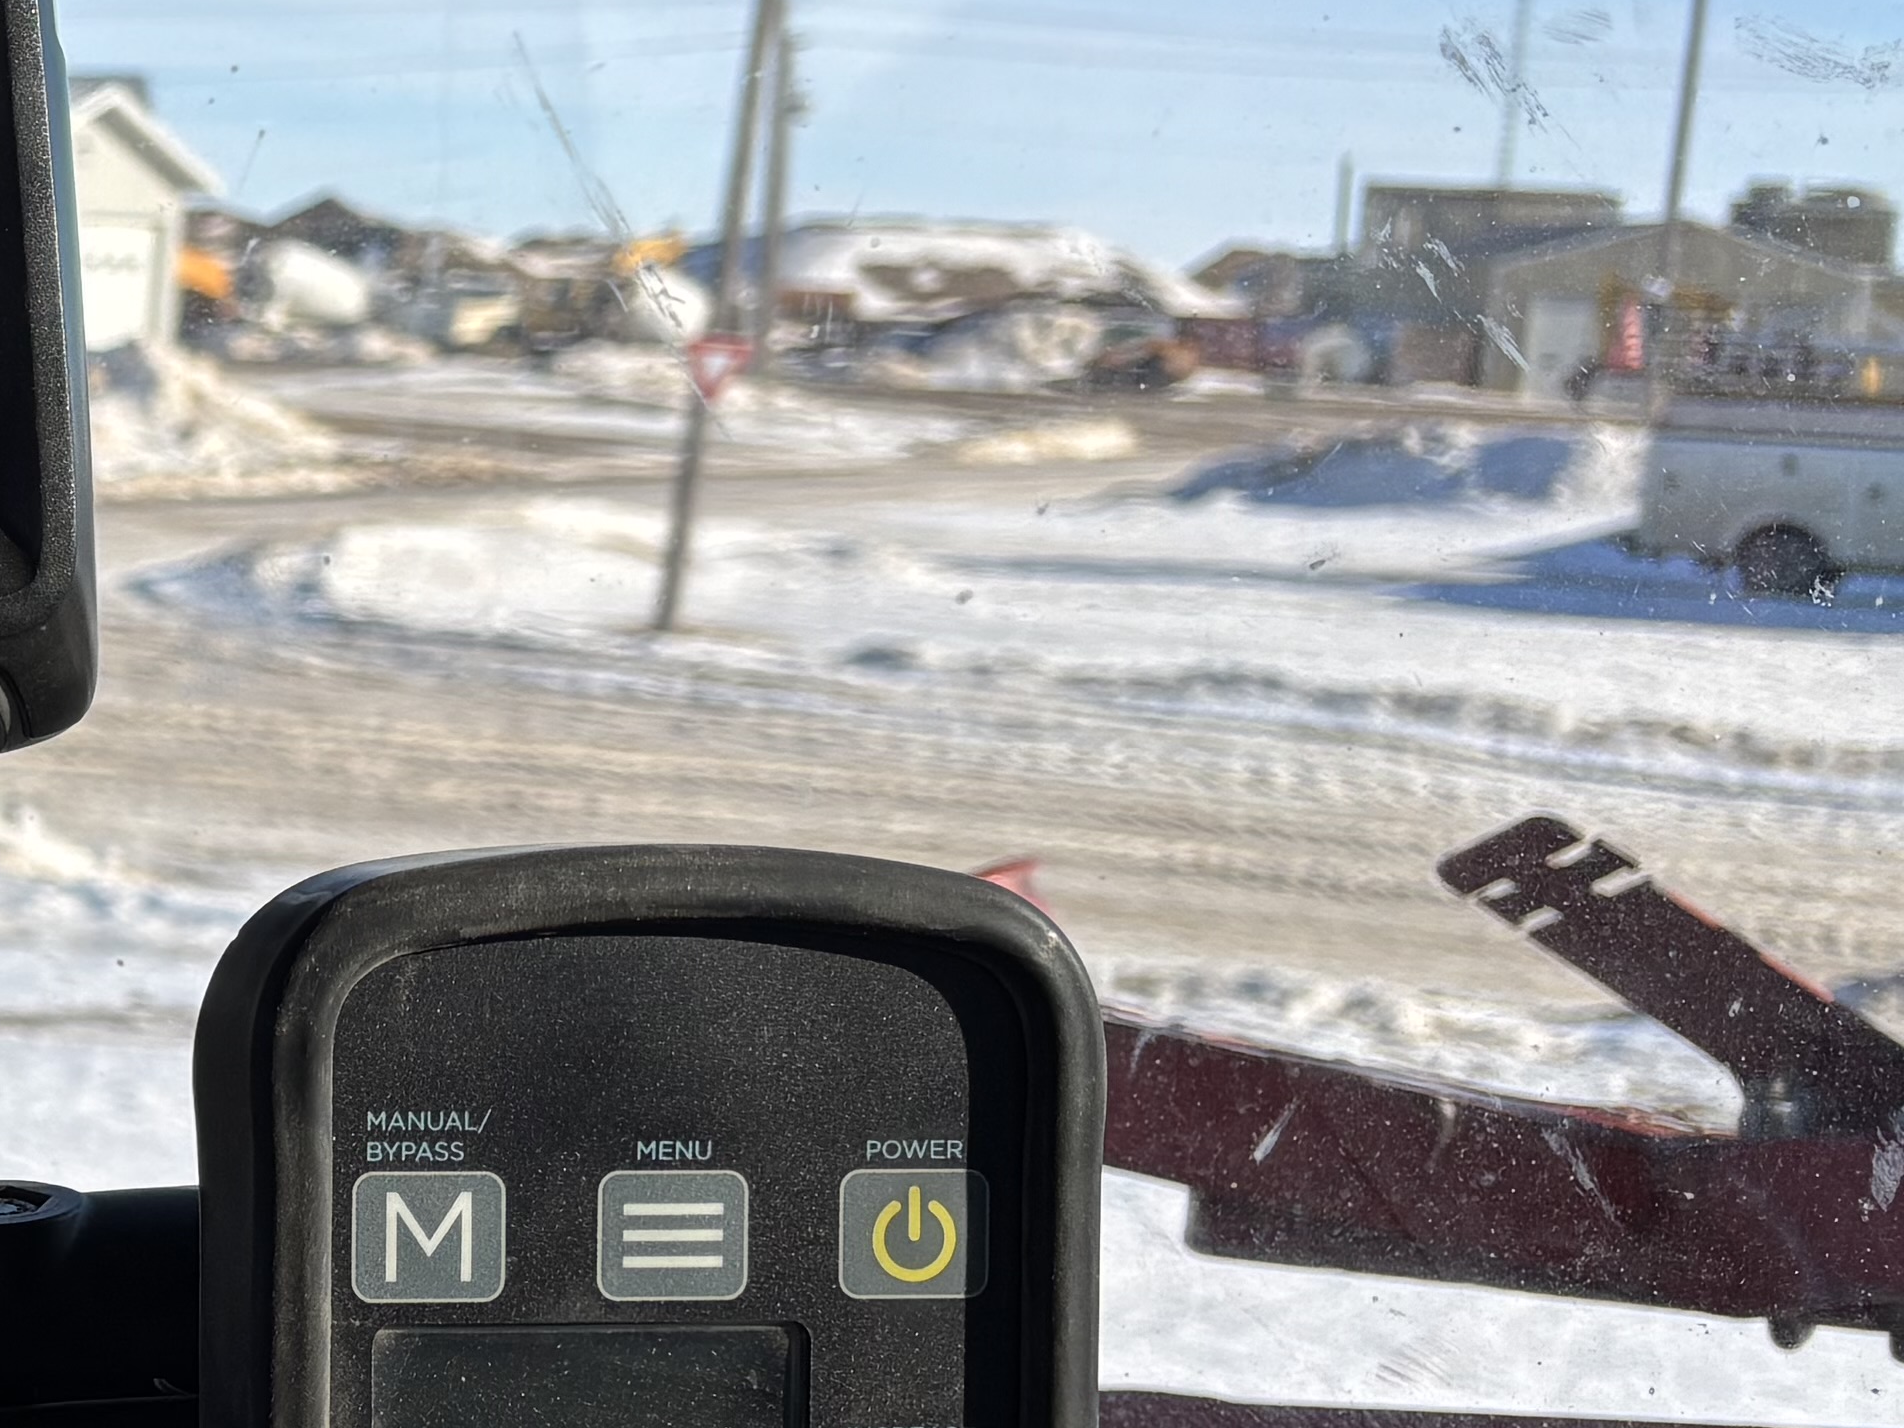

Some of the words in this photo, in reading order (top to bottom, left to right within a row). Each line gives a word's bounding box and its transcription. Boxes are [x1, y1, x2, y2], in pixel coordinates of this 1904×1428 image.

[367, 1109, 492, 1134] MANUAL/
[366, 1141, 465, 1162] BYPASS
[636, 1140, 713, 1161] MENU
[866, 1139, 964, 1161] POWER
[385, 1191, 472, 1283] M
